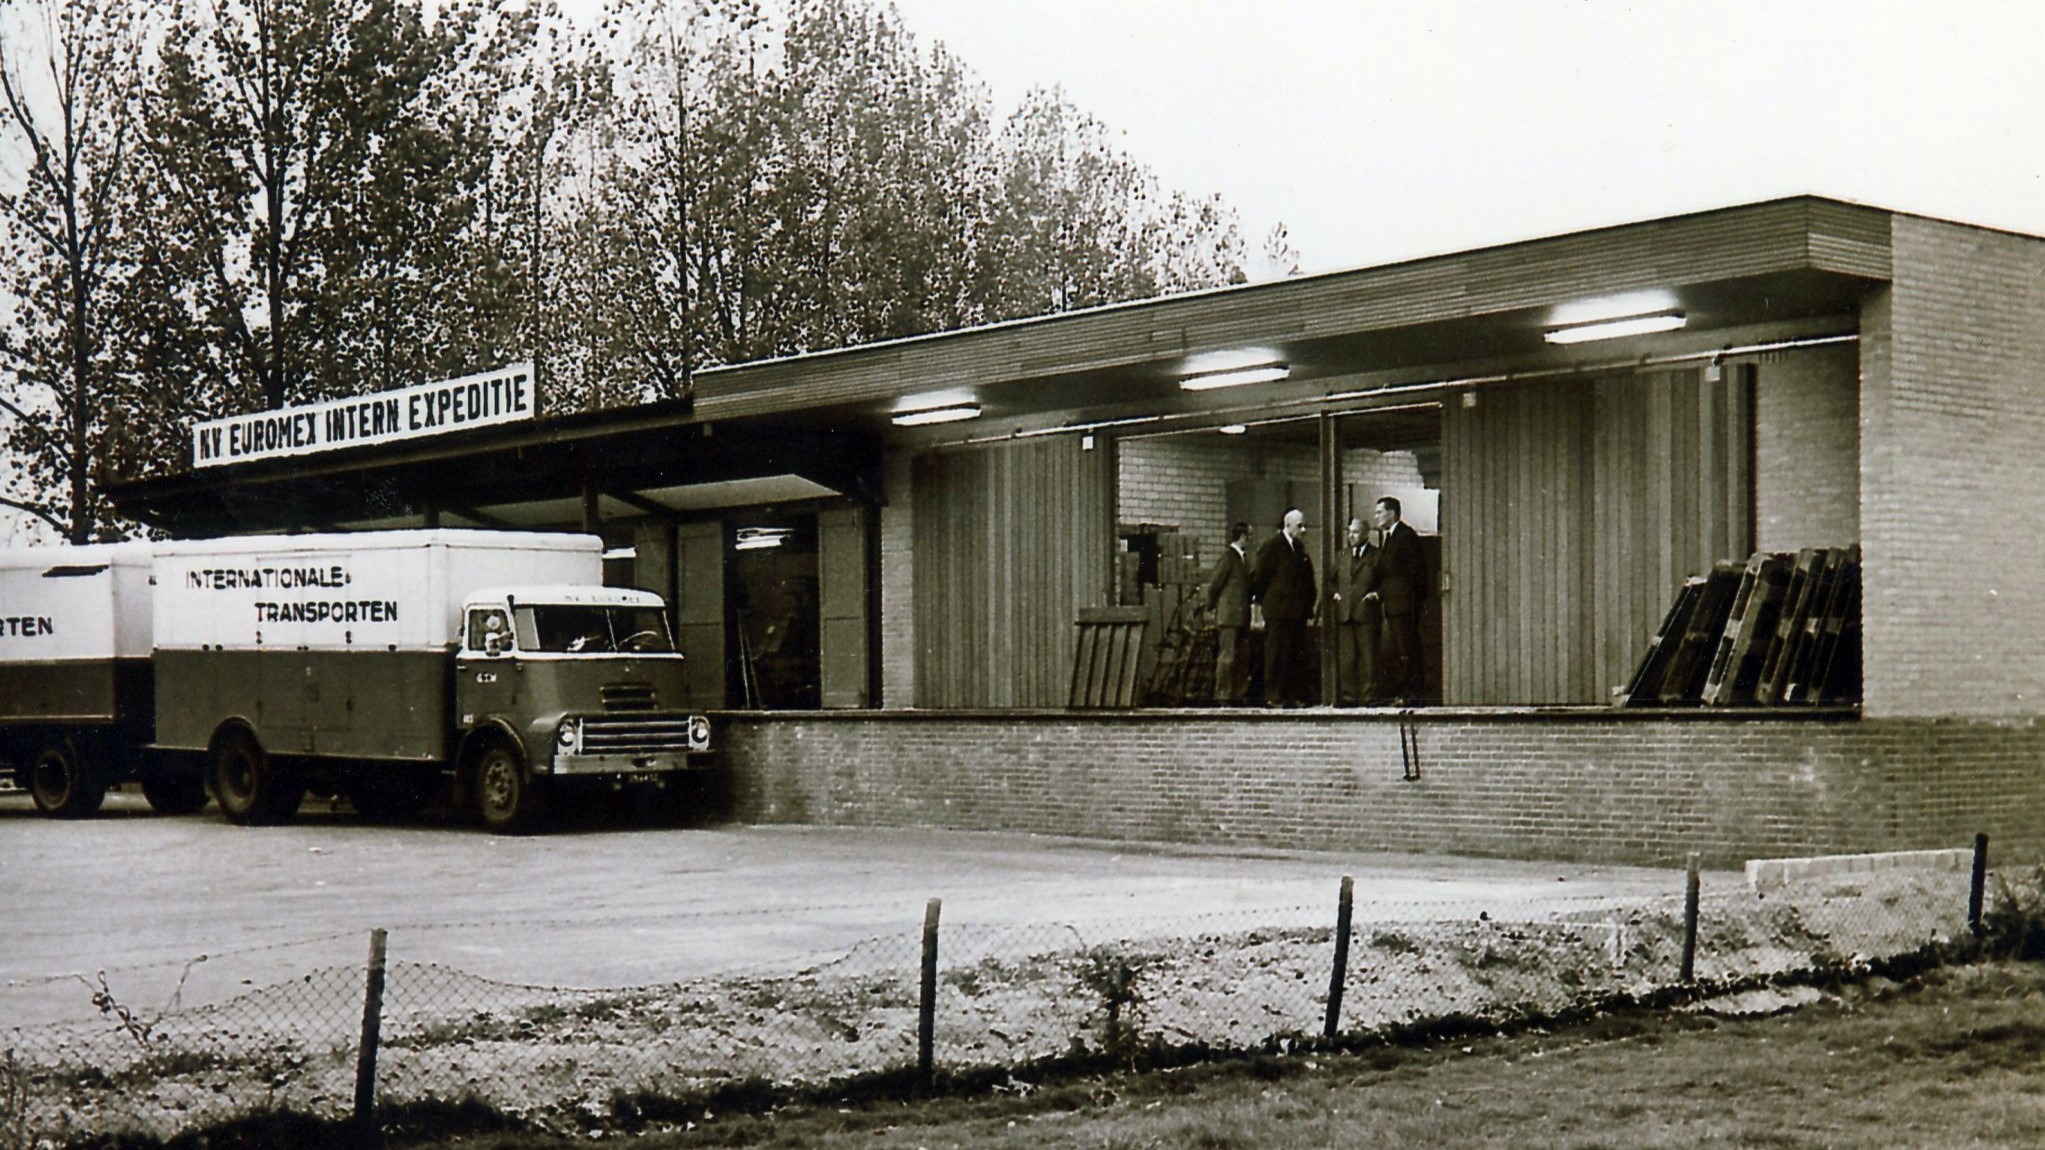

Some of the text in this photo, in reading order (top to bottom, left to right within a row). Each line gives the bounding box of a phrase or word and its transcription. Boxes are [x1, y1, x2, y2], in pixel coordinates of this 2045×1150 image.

[200, 374, 527, 460] NV EUROMEX INTERN EXPEDITIE
[186, 566, 344, 590] INTERNATIONALE
[254, 600, 398, 623] TRANSPORTEN
